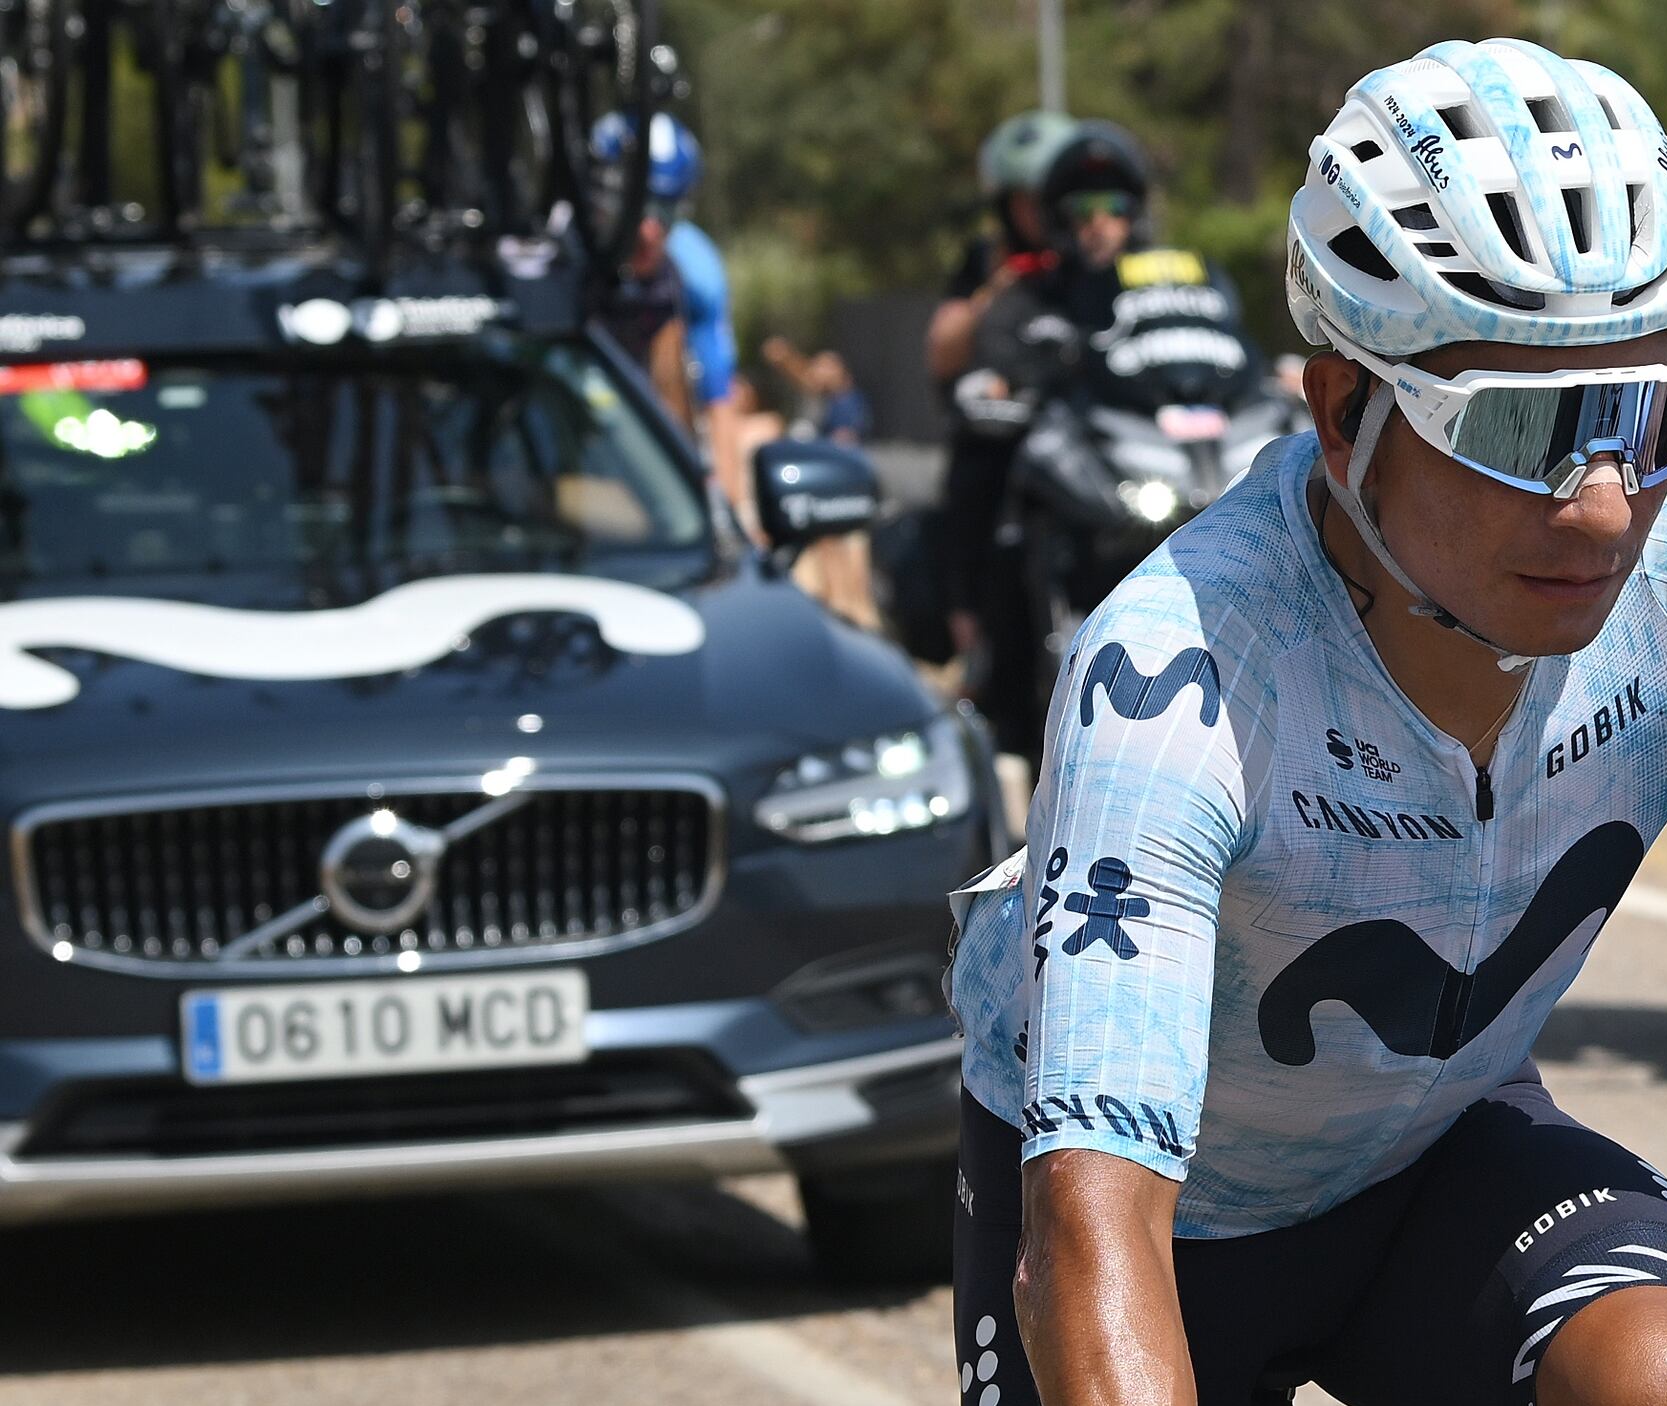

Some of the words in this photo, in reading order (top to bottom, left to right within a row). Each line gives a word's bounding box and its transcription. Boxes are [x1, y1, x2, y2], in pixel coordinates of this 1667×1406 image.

[1384, 95, 1416, 138] 1924-2024
[1411, 134, 1450, 193] Abus
[1354, 737, 1380, 758] UCI
[1546, 675, 1647, 779] GOBIK
[1357, 751, 1401, 774] WORLD
[1361, 764, 1393, 784] TEAM
[1291, 789, 1465, 840] CANYON
[237, 993, 412, 1064] 0610
[436, 984, 564, 1051] MCD
[1514, 1187, 1618, 1253] GOBIK
